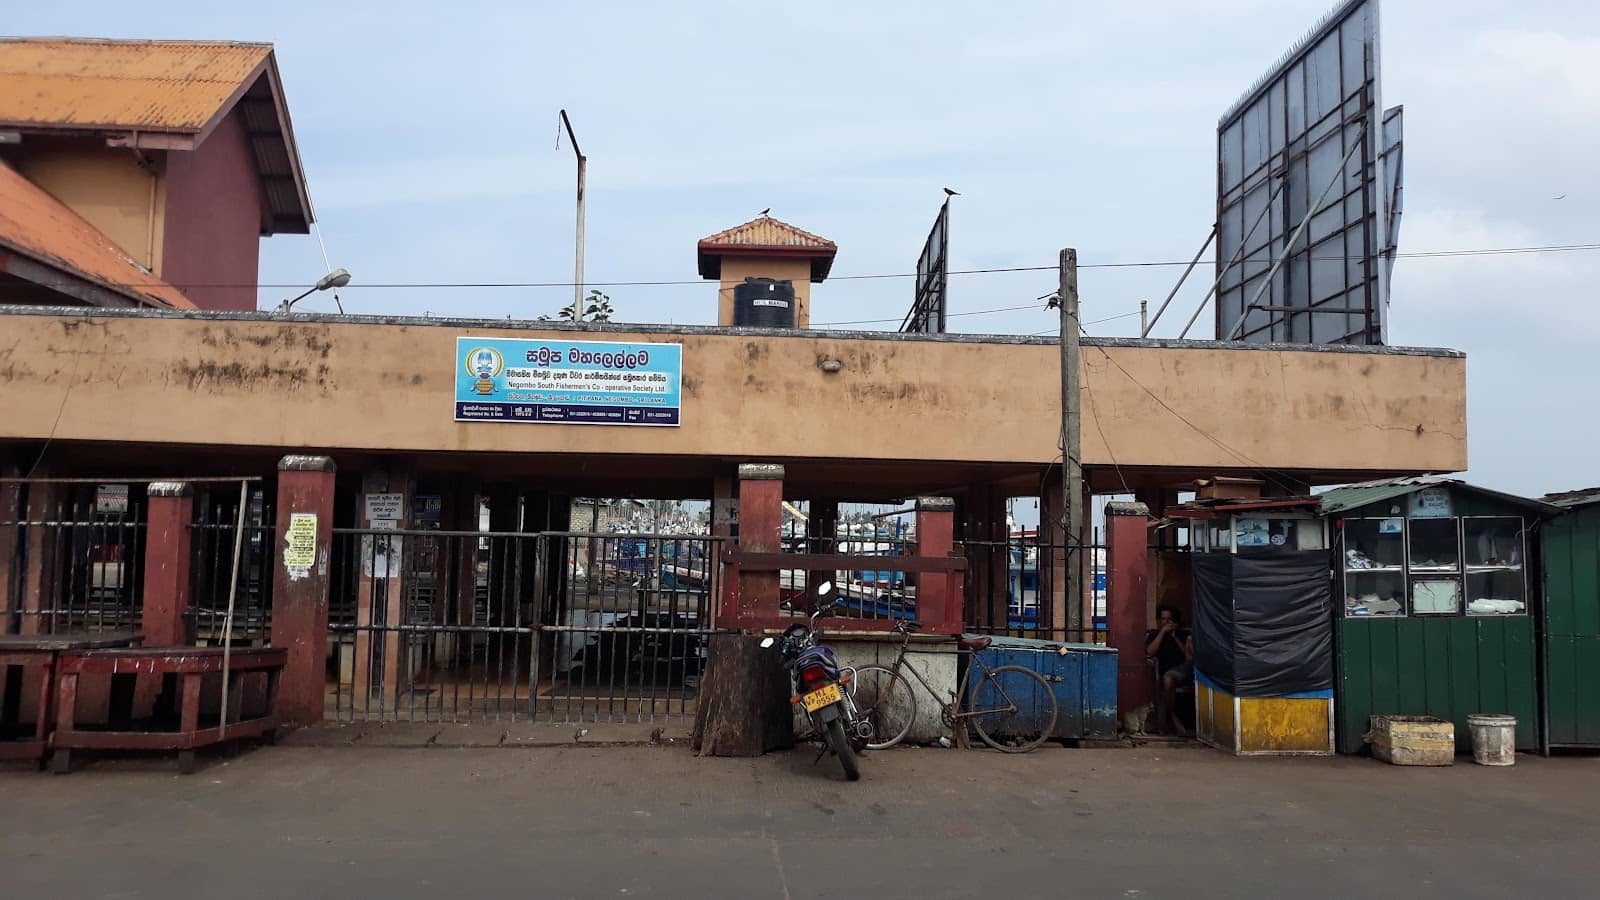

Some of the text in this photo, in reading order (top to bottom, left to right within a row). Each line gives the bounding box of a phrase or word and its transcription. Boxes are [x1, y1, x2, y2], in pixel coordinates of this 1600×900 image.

[568, 347, 649, 369] මහලෙල්ලම
[508, 381, 536, 389] Negombo
[556, 382, 590, 390] Fishermen's
[605, 384, 631, 392] operative
[632, 384, 653, 393] Society
